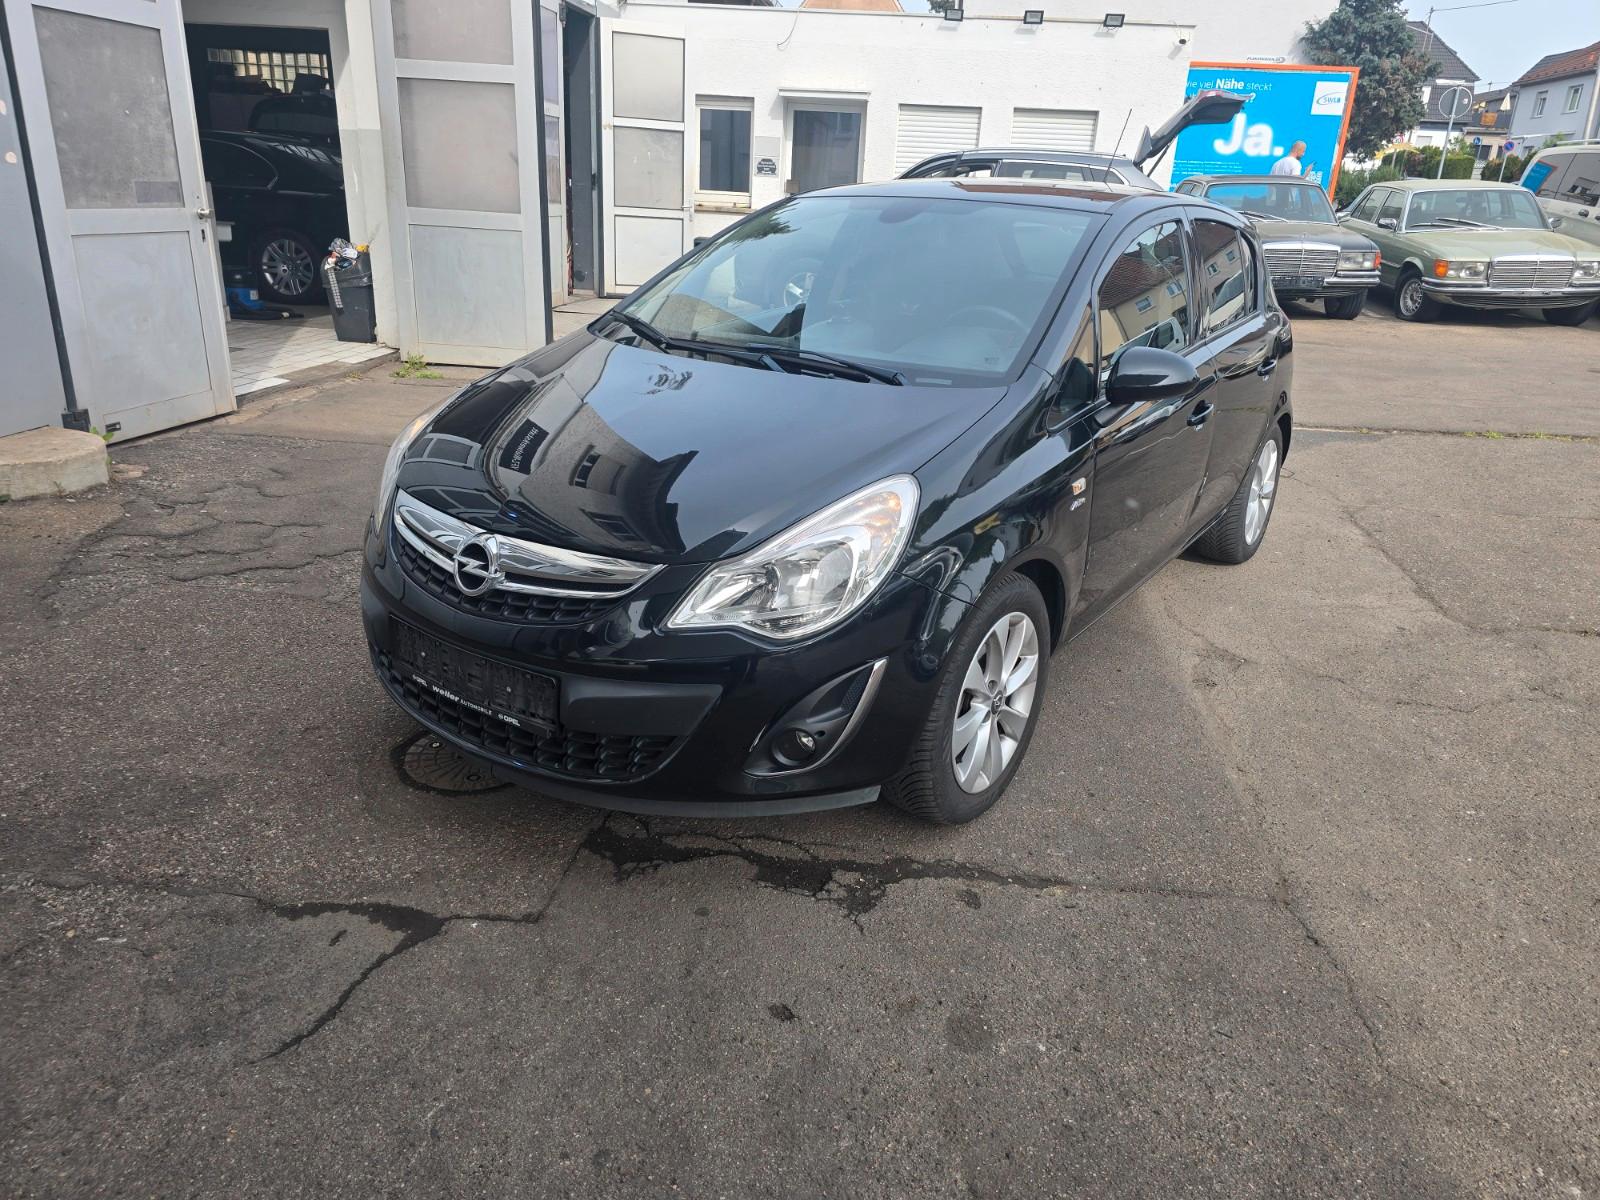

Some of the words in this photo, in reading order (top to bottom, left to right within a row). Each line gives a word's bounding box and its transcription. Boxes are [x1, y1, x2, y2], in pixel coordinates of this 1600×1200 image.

[1200, 80, 1214, 89] viel
[1216, 78, 1244, 91] Nähe
[1246, 81, 1272, 92] steckt
[1213, 112, 1284, 157] Ja.
[461, 698, 493, 716] AUTOMOBILE
[503, 715, 521, 727] OPEL
